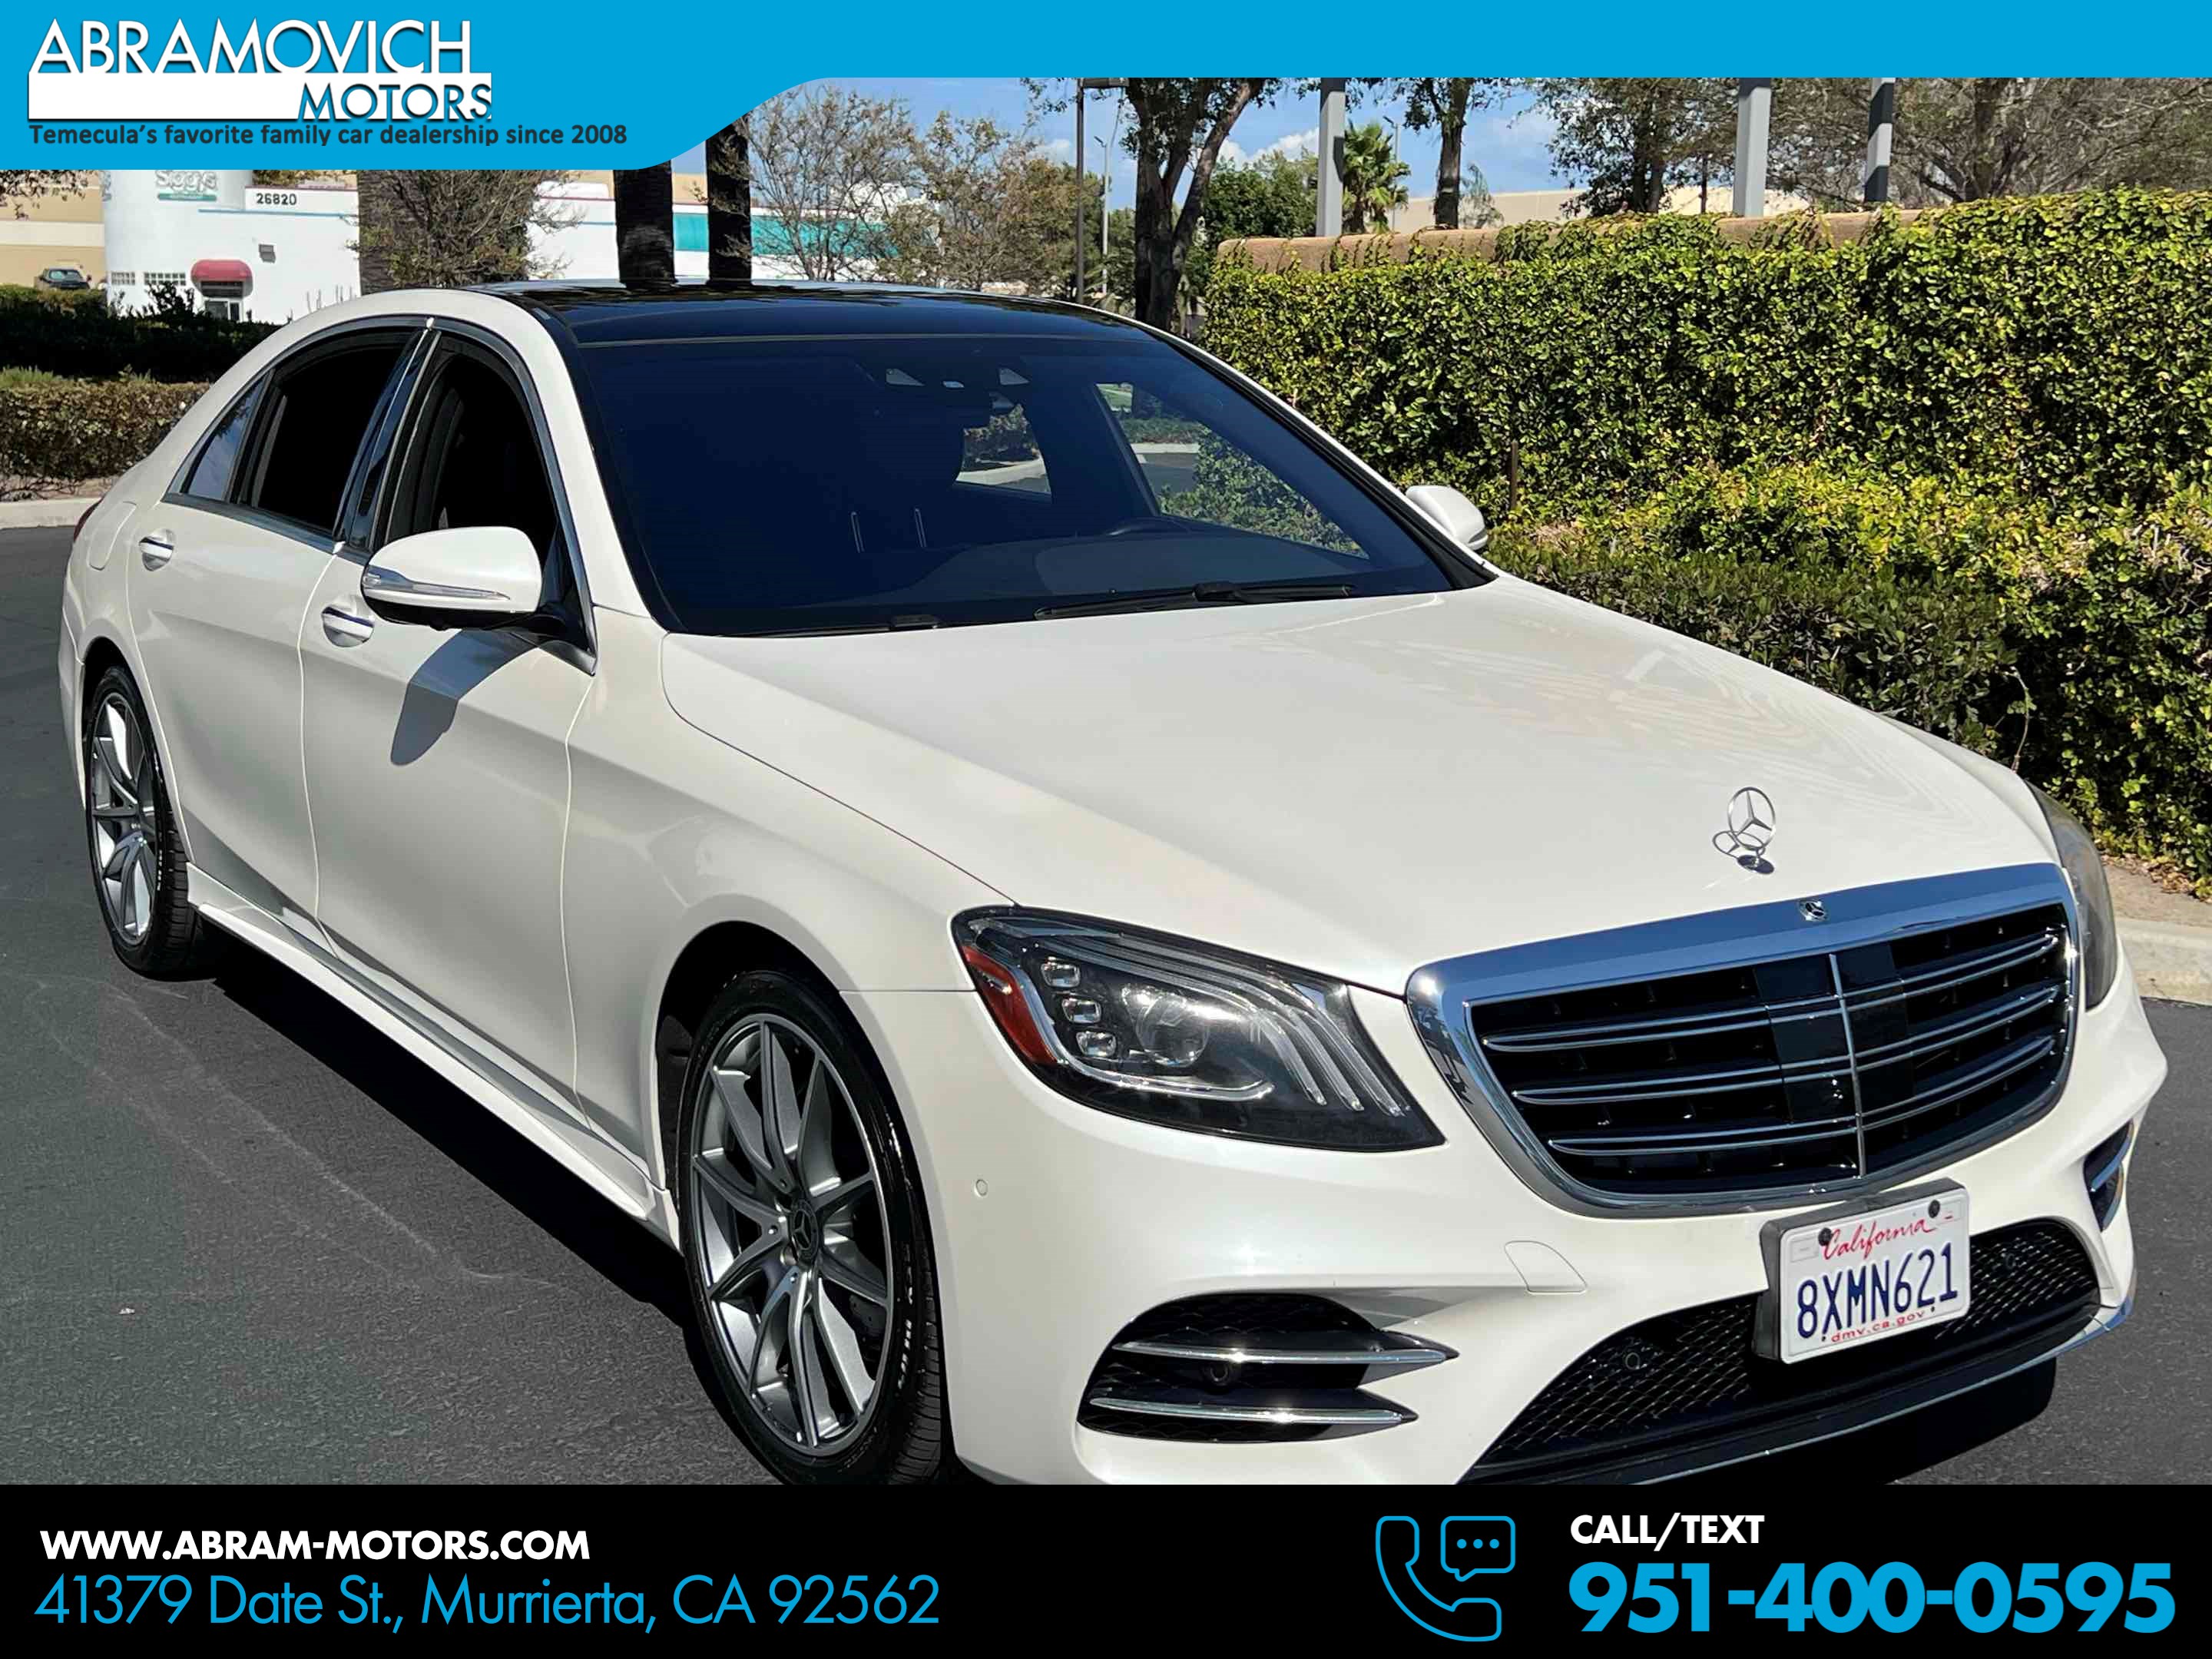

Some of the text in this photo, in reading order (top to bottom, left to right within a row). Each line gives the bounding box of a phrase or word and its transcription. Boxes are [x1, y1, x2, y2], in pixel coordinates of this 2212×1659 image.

[256, 193, 297, 206] 26820
[1823, 1219, 1937, 1260] California
[1796, 1242, 1959, 1339] 8XMN621
[1830, 1310, 1926, 1343] dmv.ca.gov
